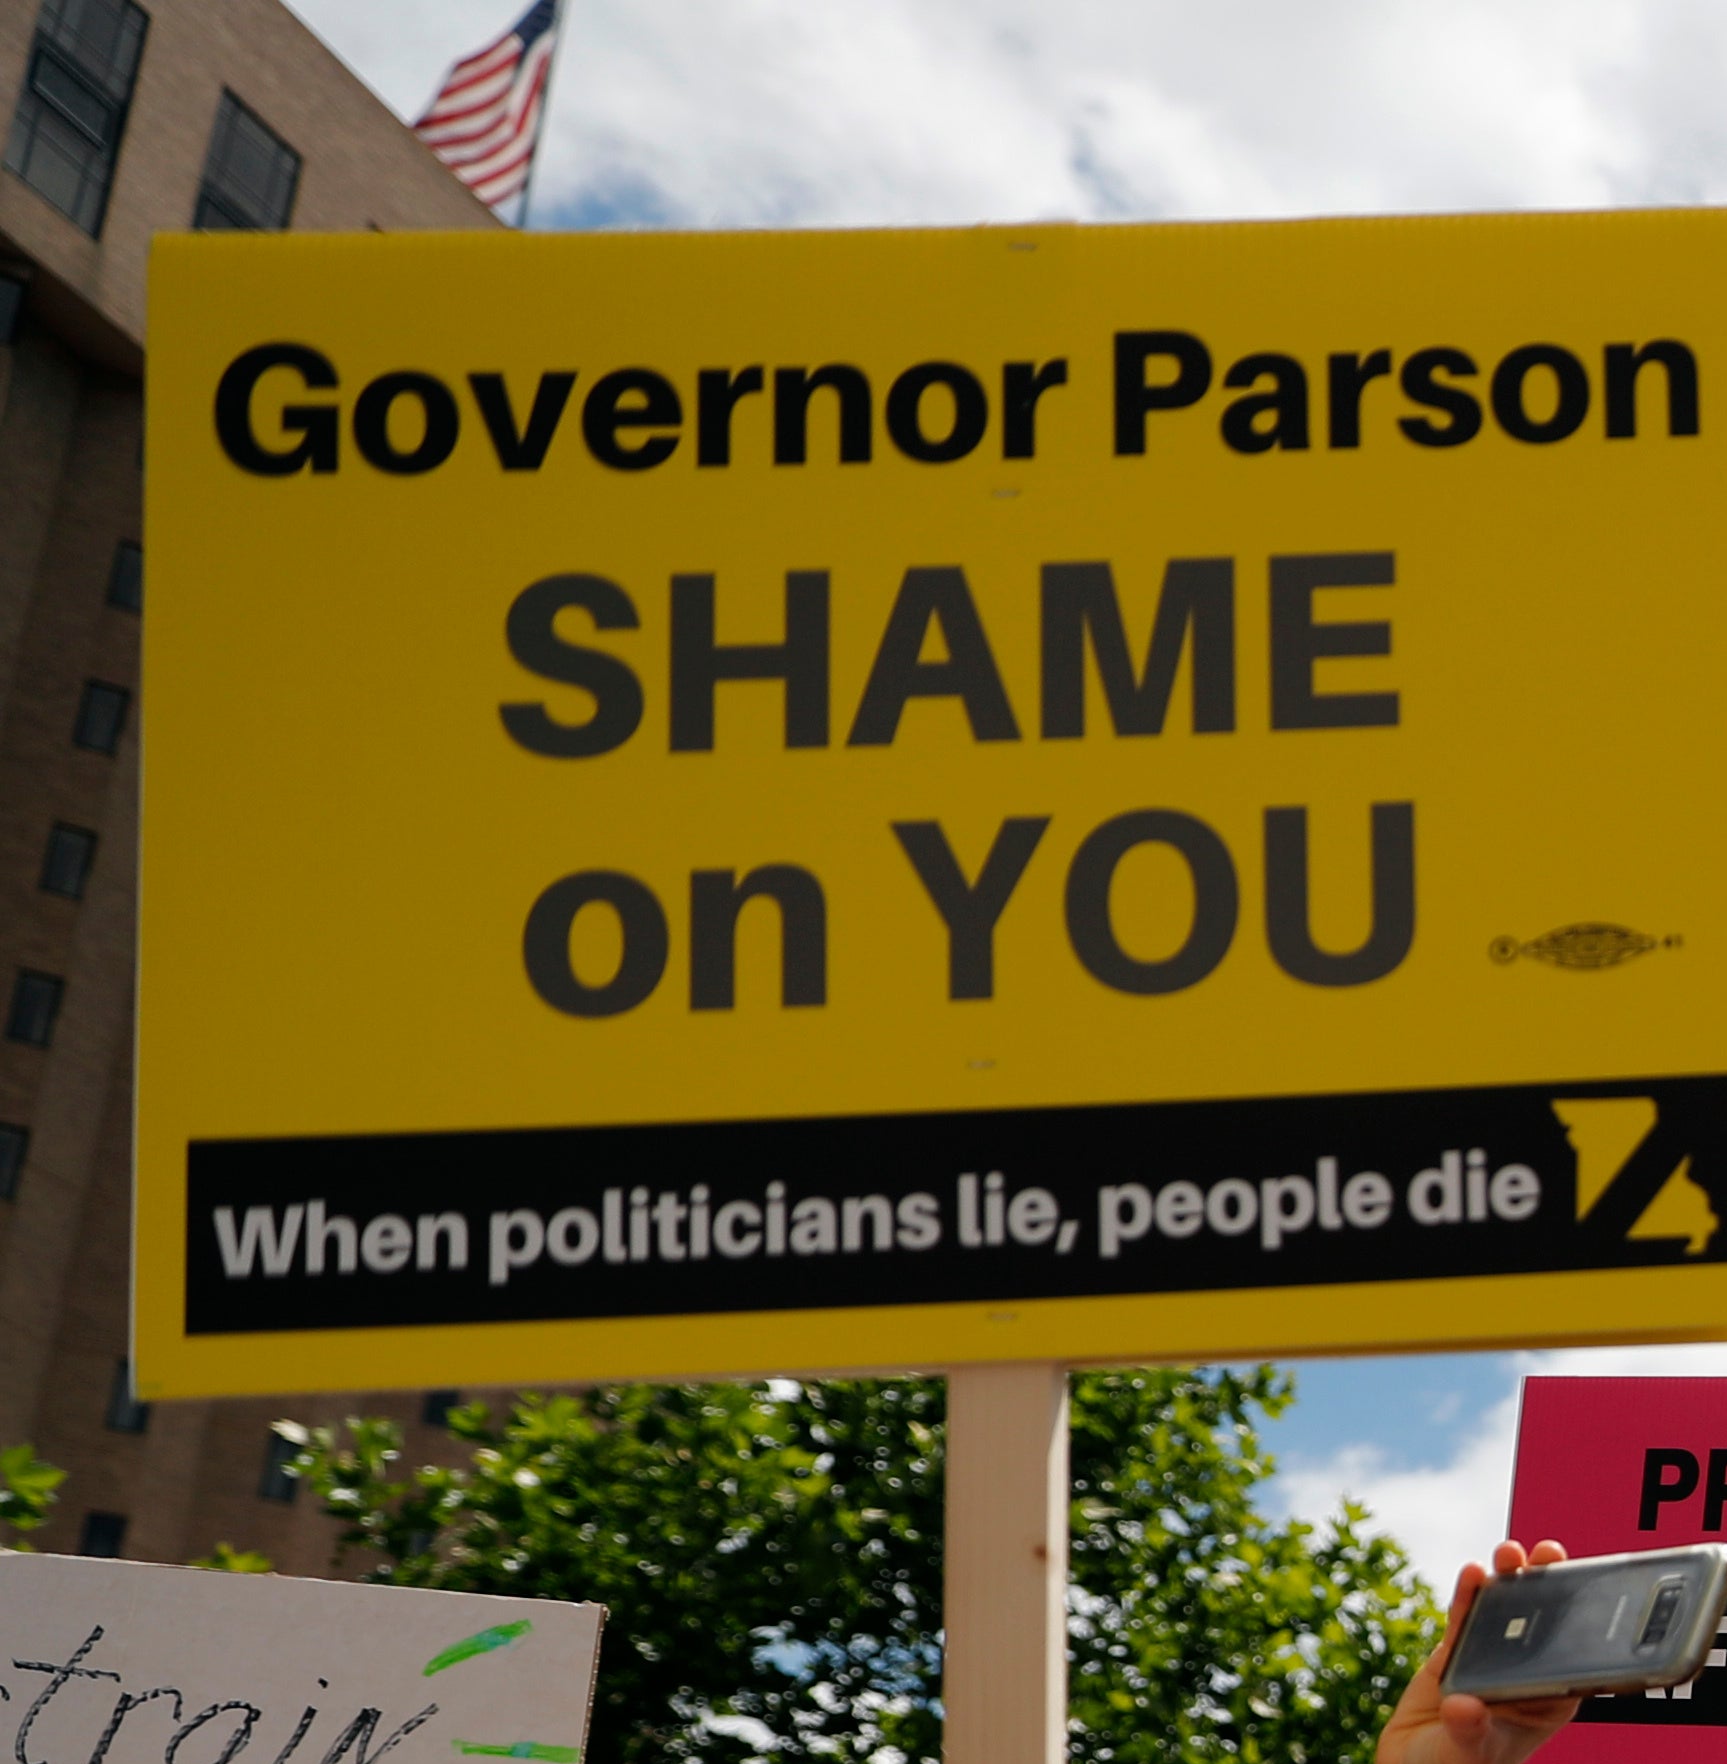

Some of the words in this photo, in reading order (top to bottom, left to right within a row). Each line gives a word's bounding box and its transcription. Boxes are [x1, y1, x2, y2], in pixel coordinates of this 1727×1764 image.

[215, 340, 1068, 478] Governor
[1112, 330, 1702, 457] Parson
[498, 550, 1401, 762] SHAME
[521, 861, 829, 1020] on
[889, 800, 1417, 1002] YOU
[213, 1200, 470, 1279] When
[488, 1180, 942, 1286] politicians
[958, 1171, 1081, 1254] lie,
[1099, 1156, 1393, 1258] people
[1407, 1148, 1541, 1225] die
